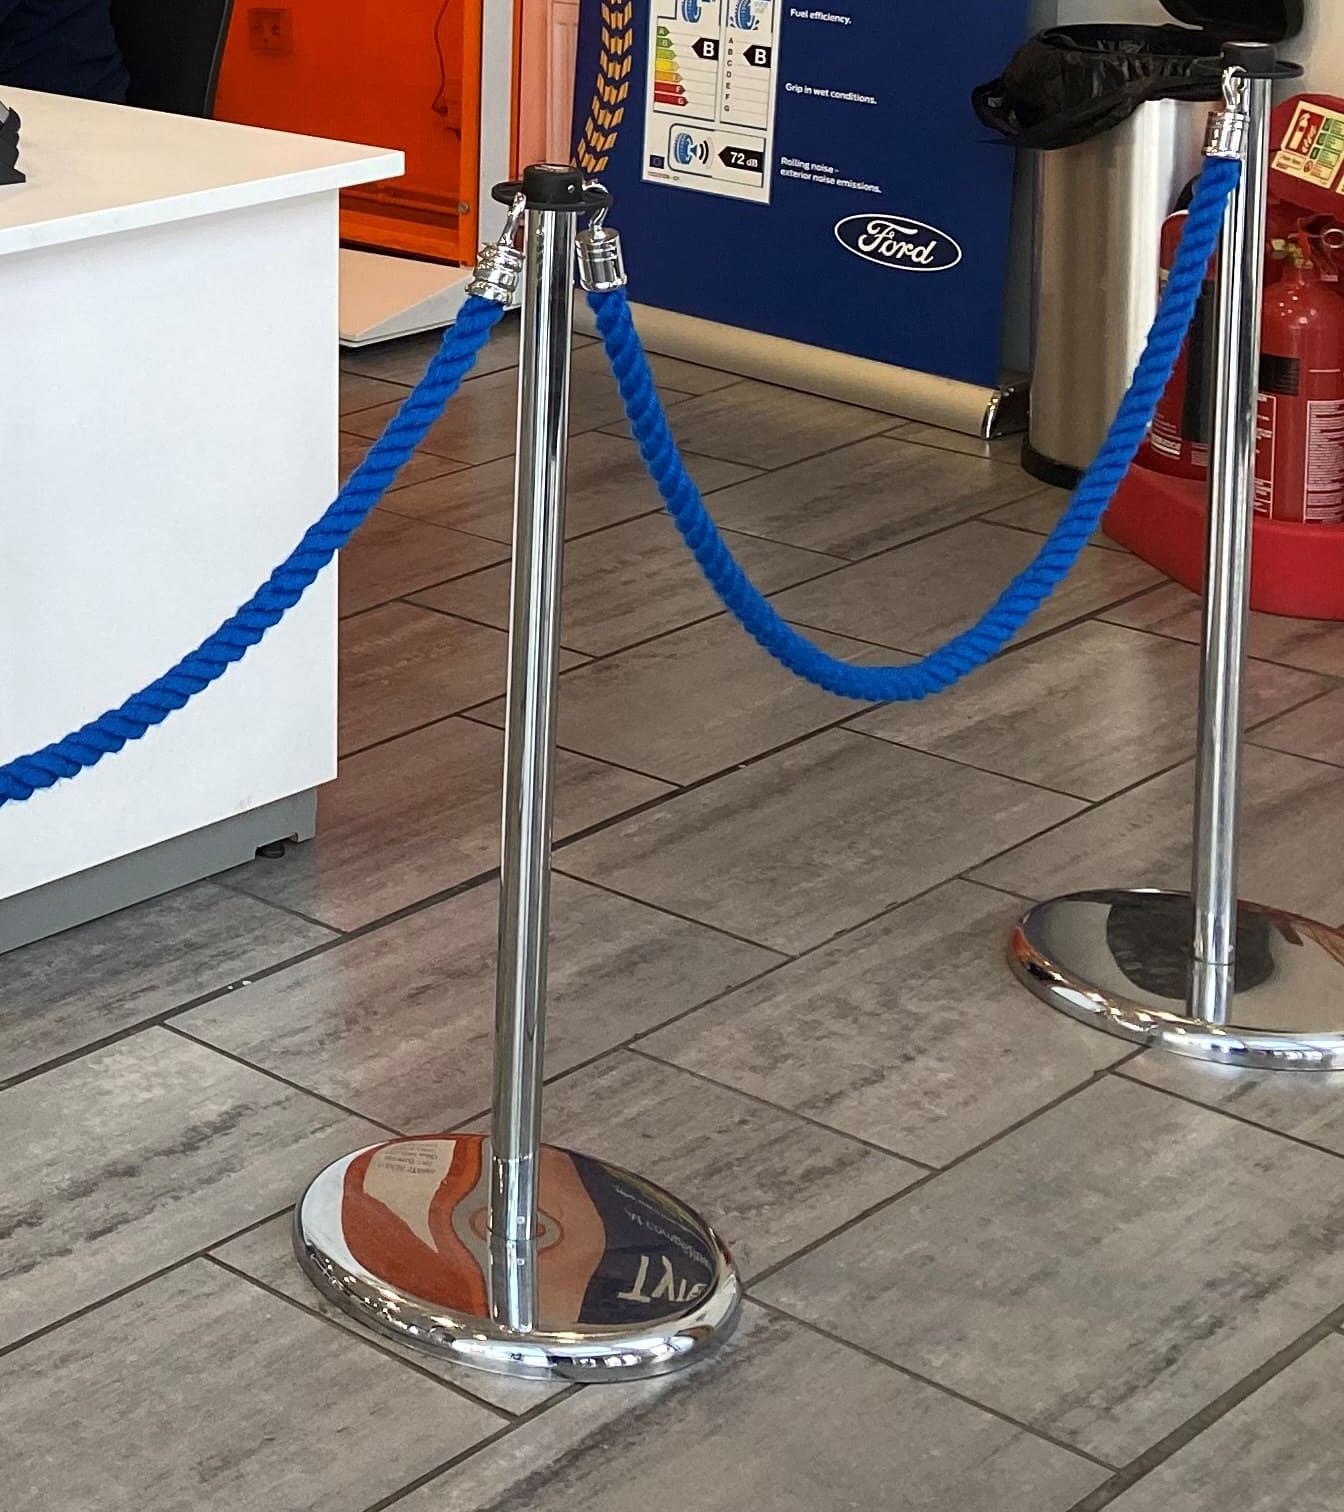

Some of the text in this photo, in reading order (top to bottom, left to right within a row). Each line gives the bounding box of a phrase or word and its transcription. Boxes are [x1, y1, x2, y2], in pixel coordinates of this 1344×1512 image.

[730, 151, 758, 168] 72 dB
[858, 220, 936, 265] Ford
